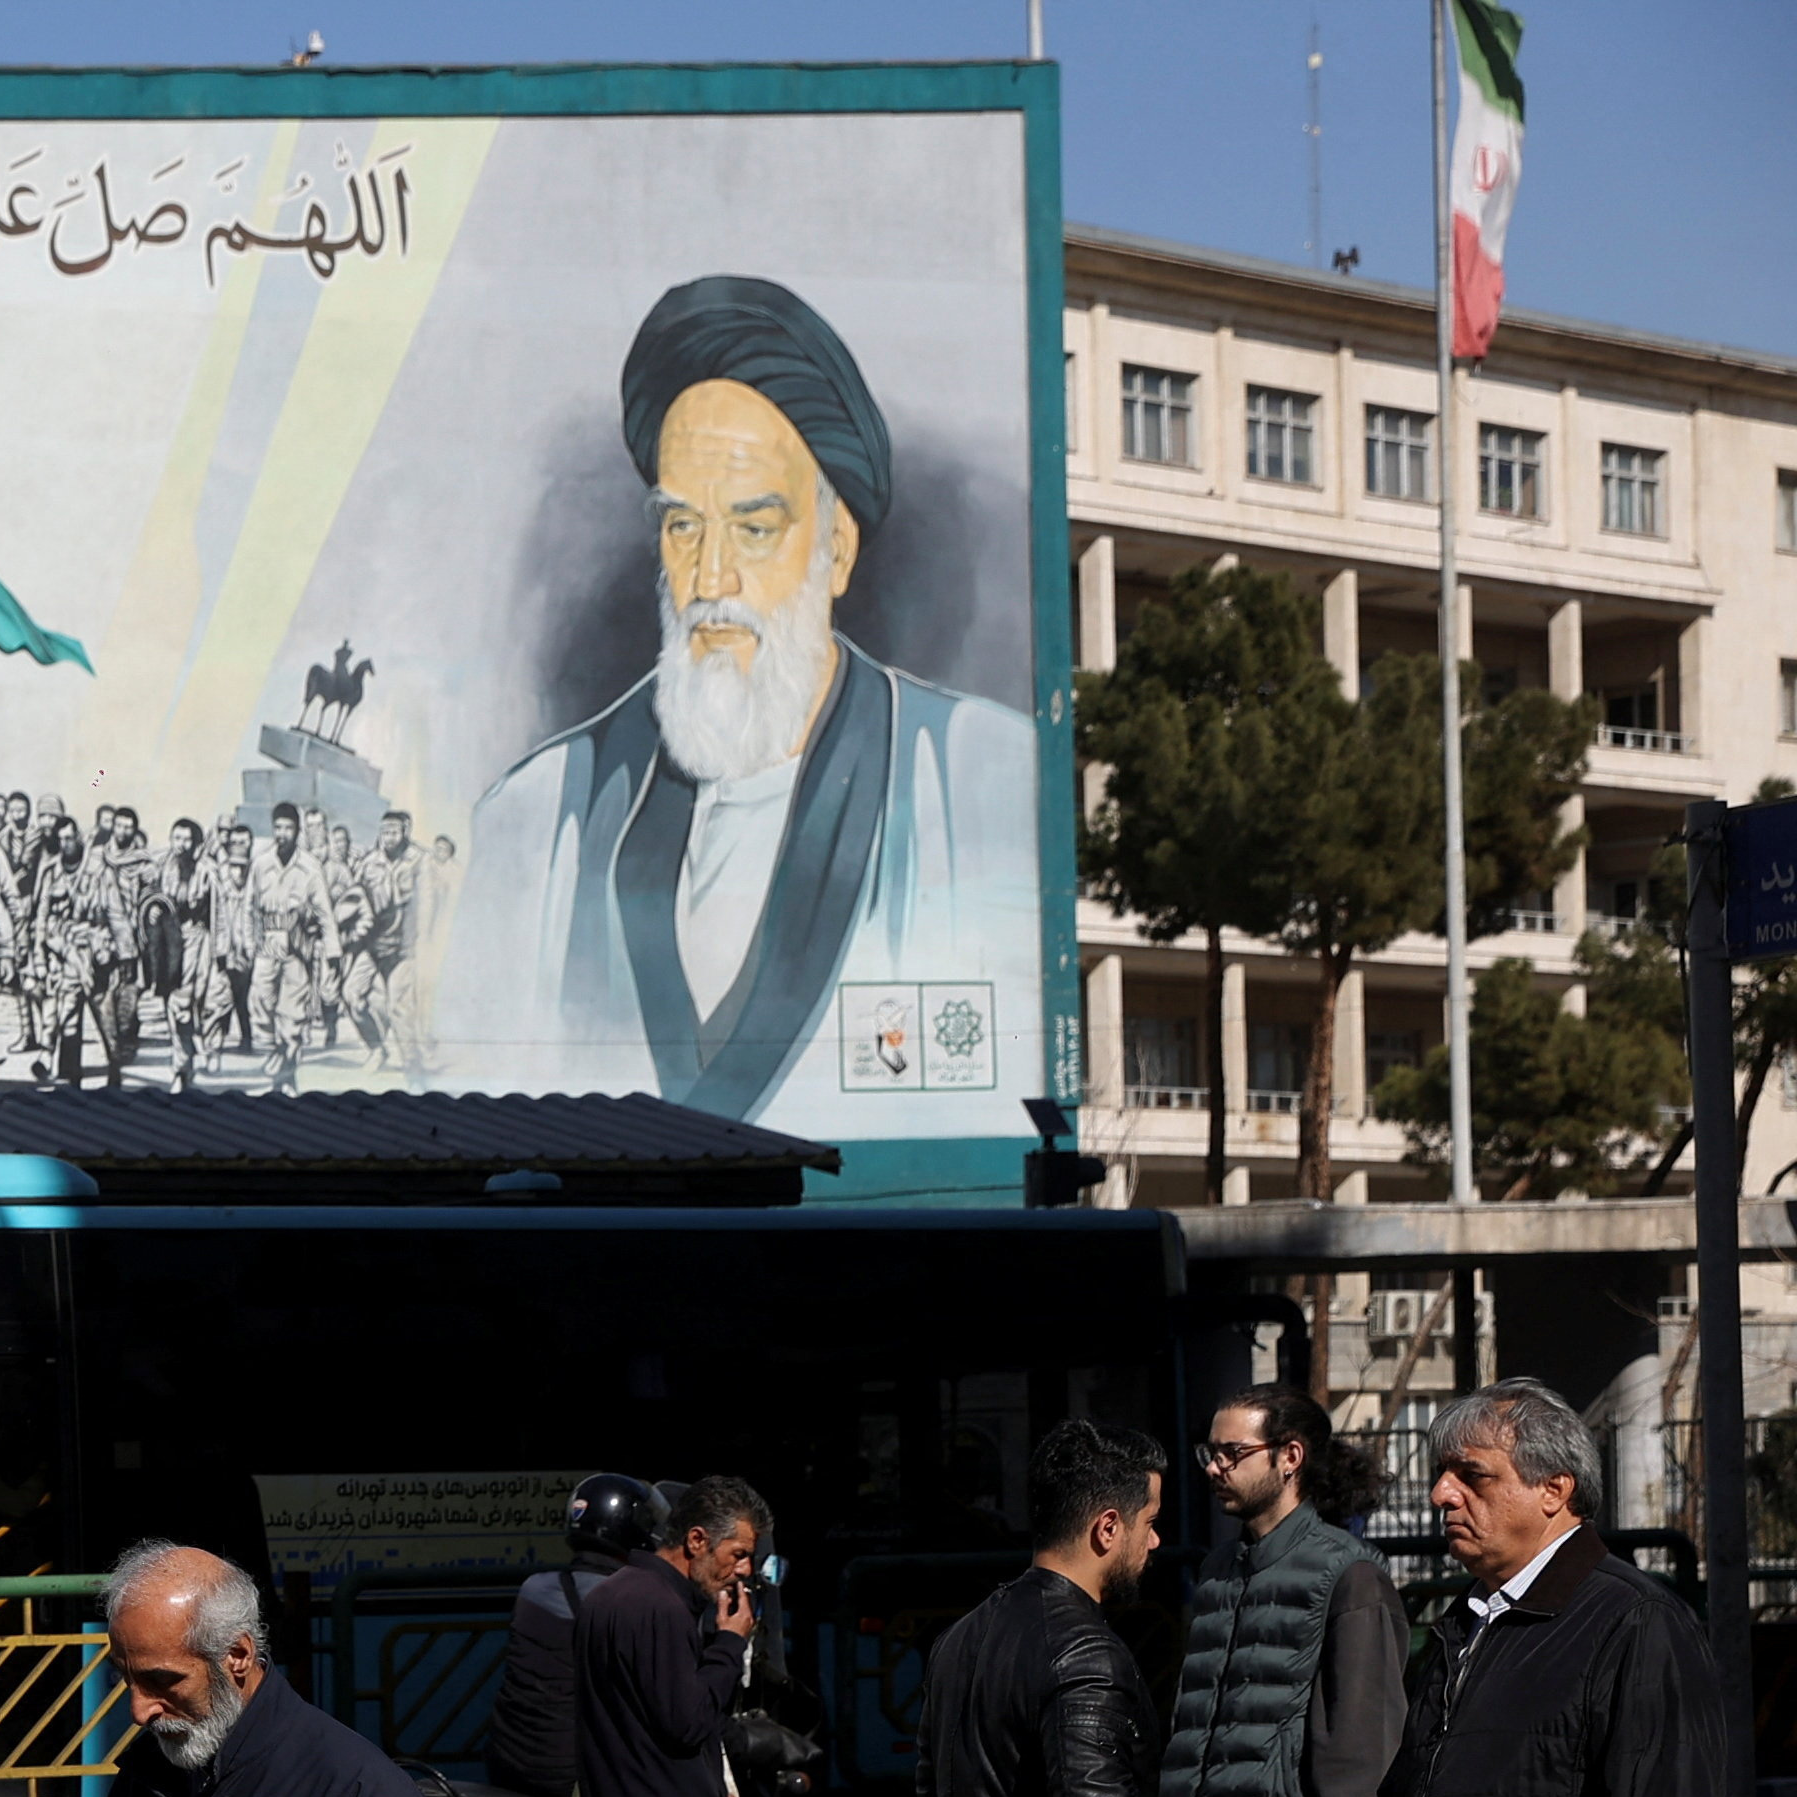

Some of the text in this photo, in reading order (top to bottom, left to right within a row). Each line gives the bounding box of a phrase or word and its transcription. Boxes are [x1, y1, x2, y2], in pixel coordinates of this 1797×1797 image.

[336, 1477, 387, 1503] تهرانه
[389, 1479, 429, 1499] جدید
[443, 1508, 479, 1525] شما
[481, 1507, 534, 1529] عوارض
